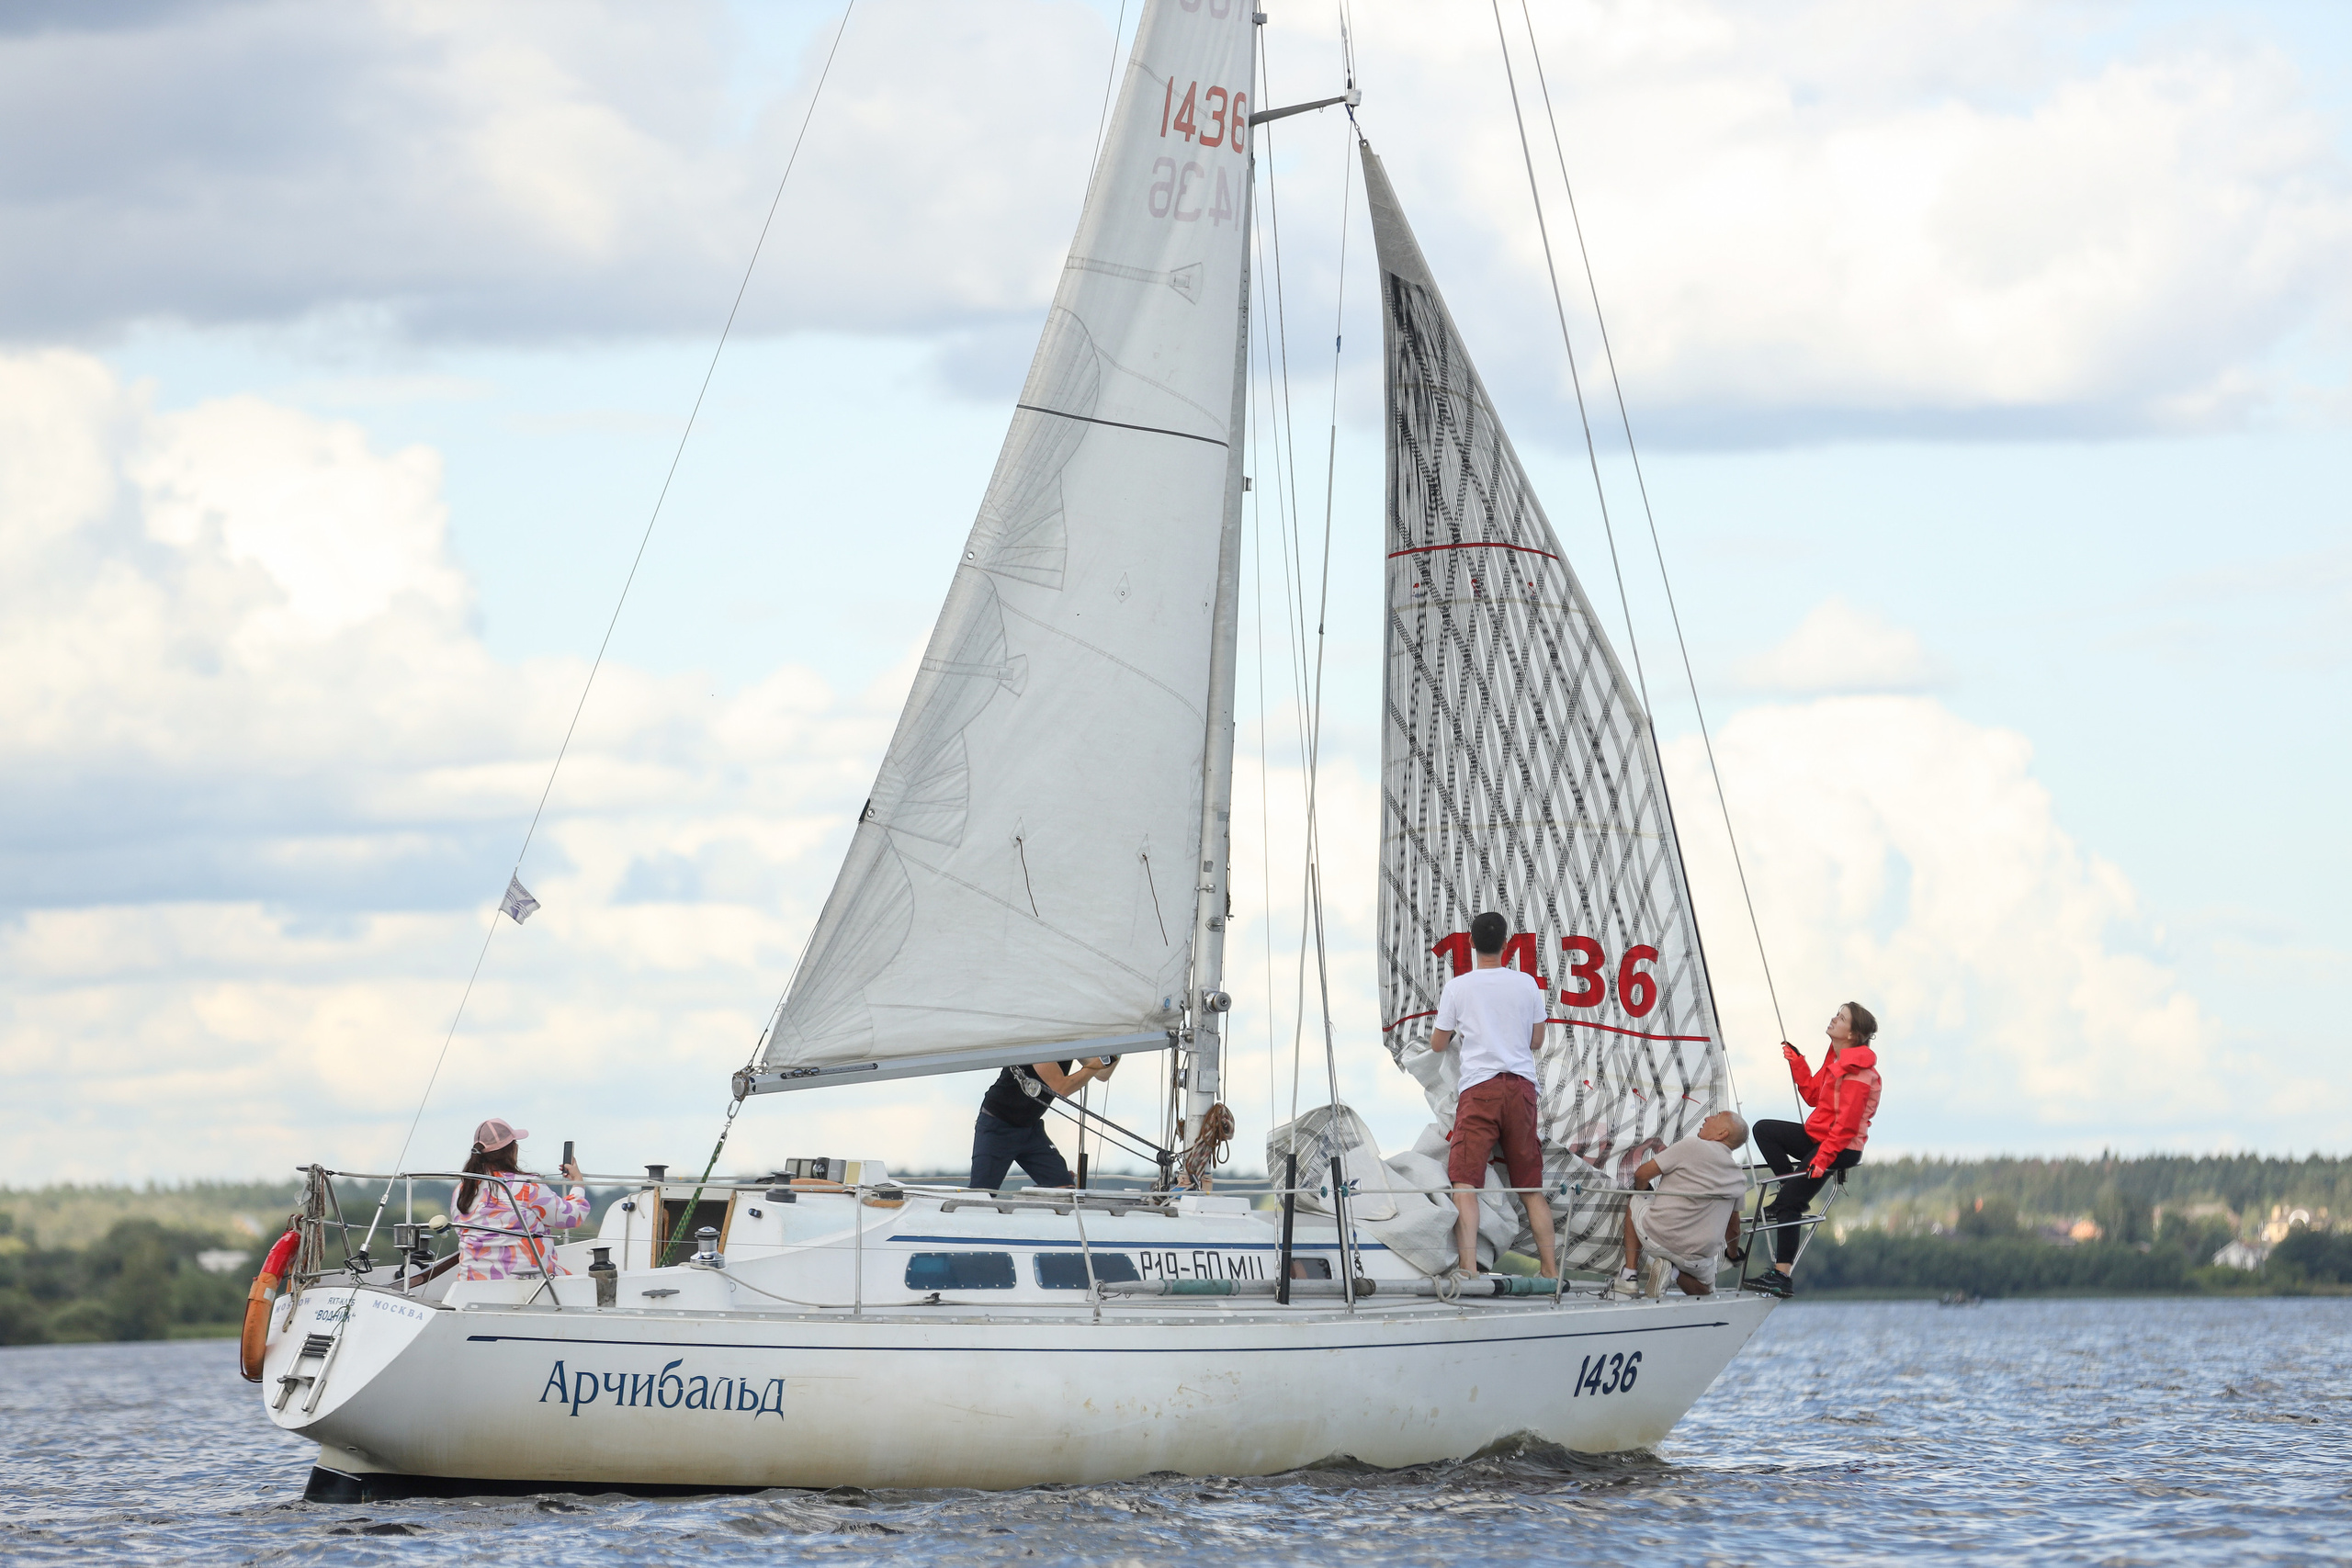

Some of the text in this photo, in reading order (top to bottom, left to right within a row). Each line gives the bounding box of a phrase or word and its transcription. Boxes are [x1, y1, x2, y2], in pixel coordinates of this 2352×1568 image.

[1159, 75, 1247, 154] 1436
[275, 1297, 312, 1314] MOSOW
[327, 1296, 356, 1307] ЯХТ-КЛБ
[372, 1299, 424, 1321] МОСКВА
[538, 1358, 785, 1422] Арчибальд
[1573, 1350, 1643, 1398] 1436
